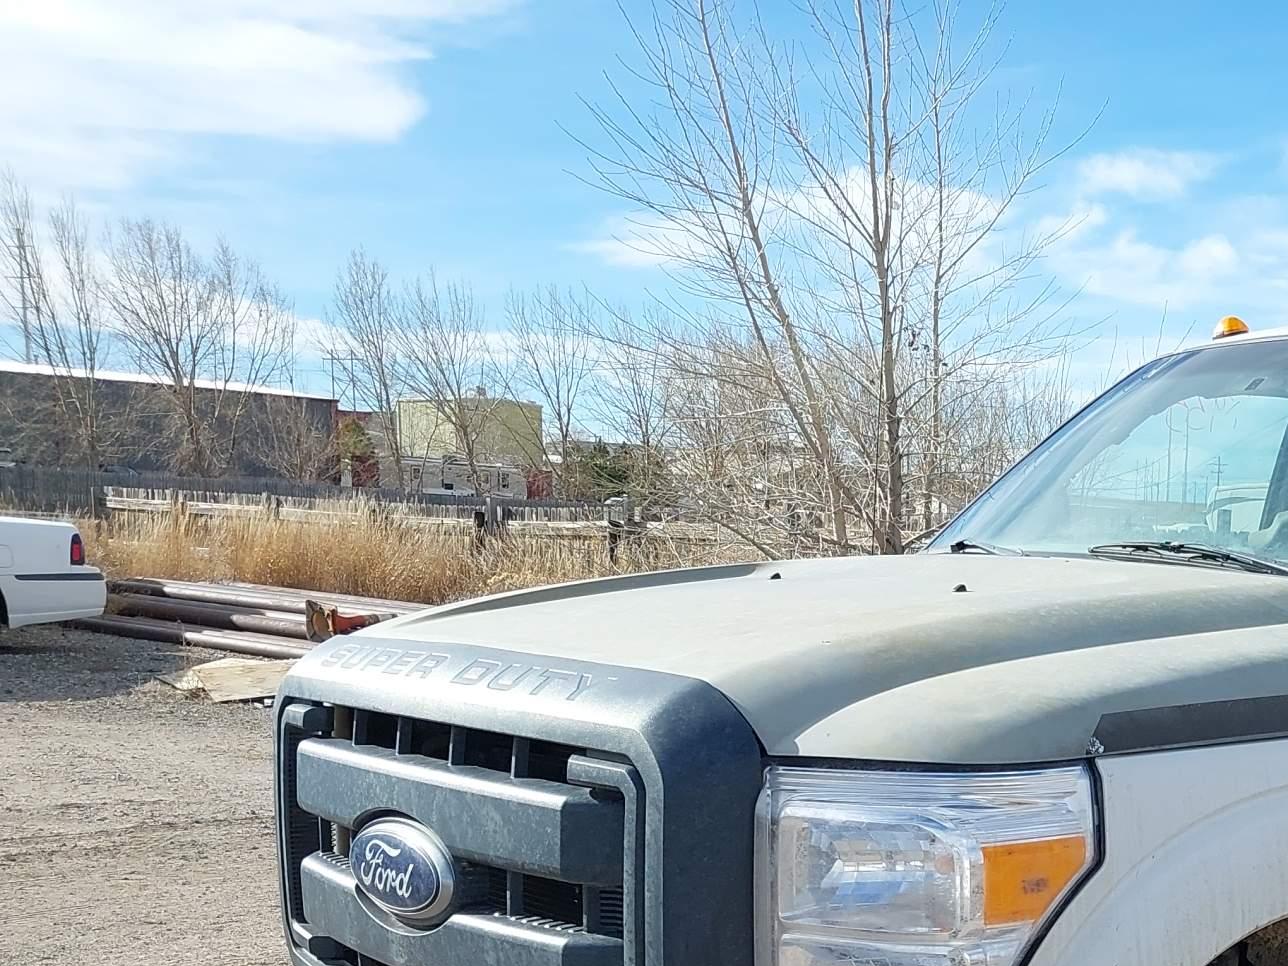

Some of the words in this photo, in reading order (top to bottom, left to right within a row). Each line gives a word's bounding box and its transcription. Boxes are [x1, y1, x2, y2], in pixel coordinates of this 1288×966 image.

[320, 643, 450, 679] SUPER
[450, 658, 593, 701] DUTY
[360, 838, 415, 899] Ford
